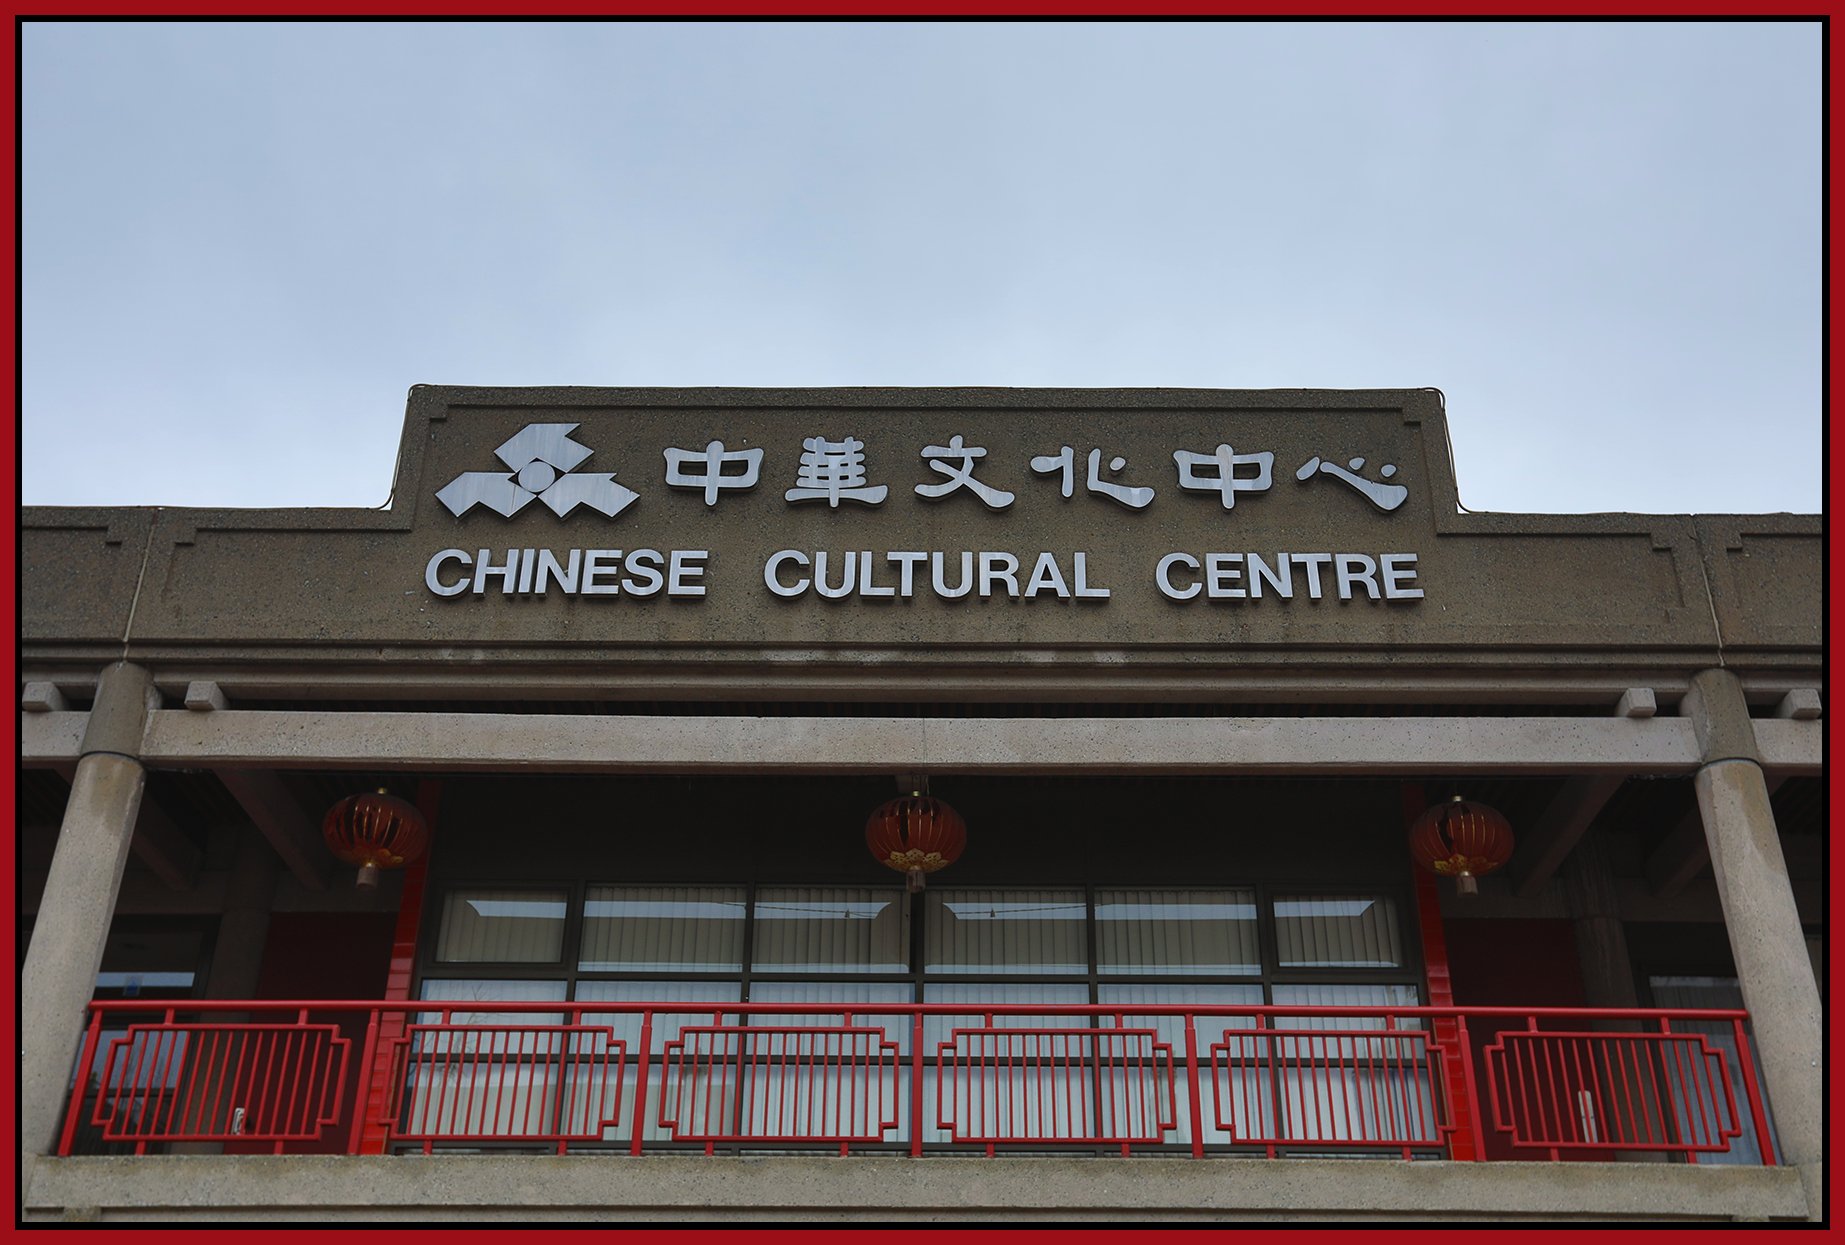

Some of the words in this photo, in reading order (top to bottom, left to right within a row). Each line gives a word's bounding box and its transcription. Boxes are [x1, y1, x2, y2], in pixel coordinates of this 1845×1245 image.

[663, 435, 1408, 511] 中華文化中心
[424, 548, 708, 598] CHINESE
[764, 549, 1110, 599] CULTURAL
[1155, 551, 1425, 601] CENTRE
